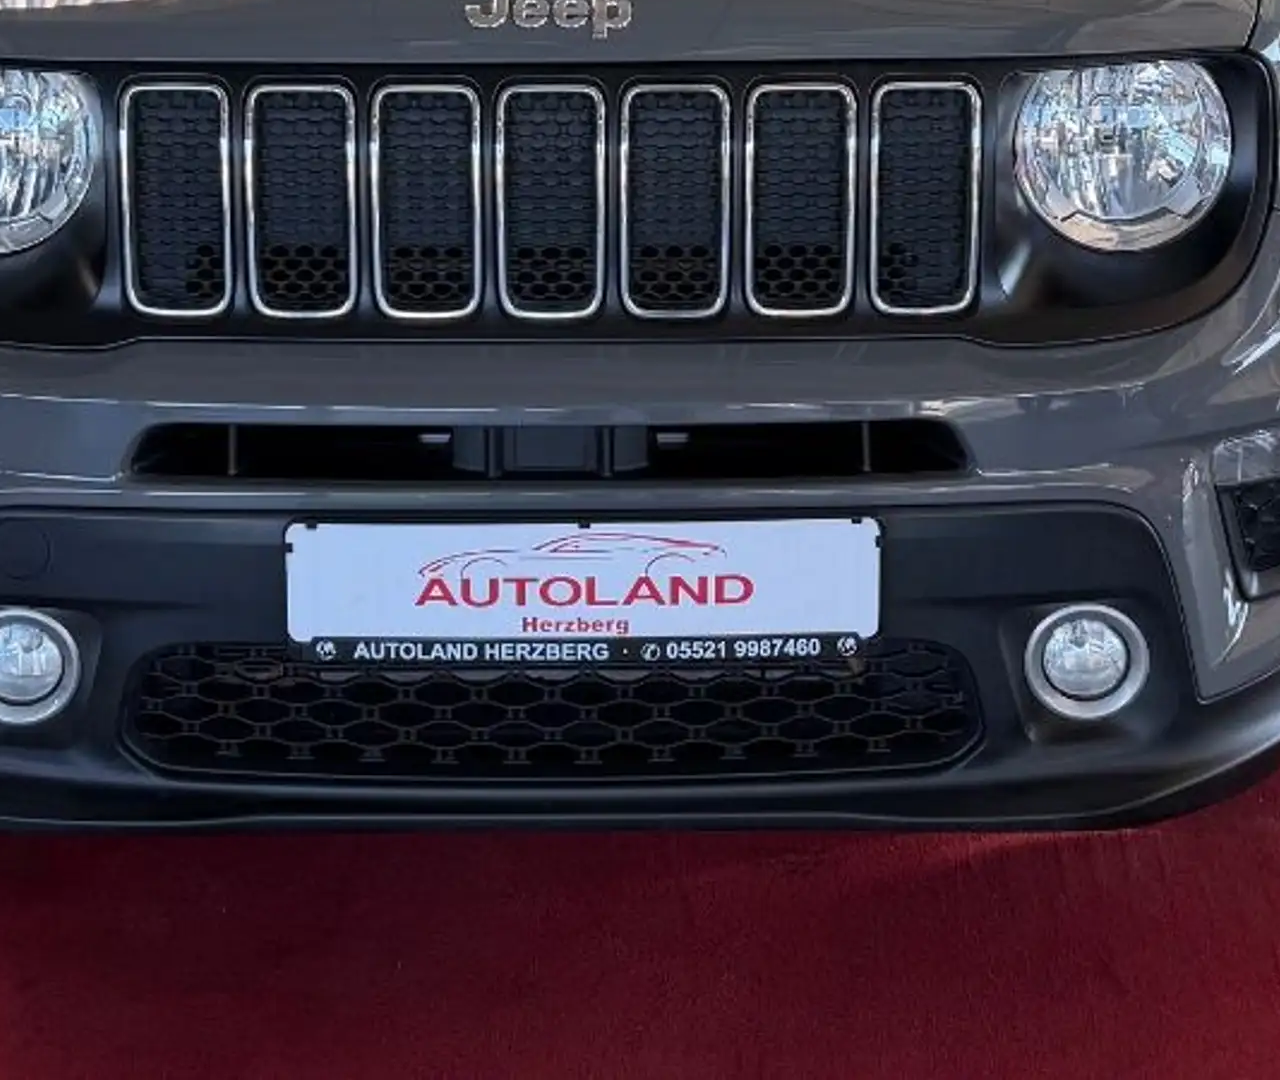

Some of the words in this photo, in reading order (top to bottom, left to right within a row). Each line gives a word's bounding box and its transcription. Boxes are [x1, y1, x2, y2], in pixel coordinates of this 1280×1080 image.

[414, 574, 755, 607] AUTOLAND
[522, 617, 630, 635] Herzberg
[354, 641, 478, 661] AUTOLAND
[485, 642, 610, 661] HERZBERG
[666, 640, 727, 660] 05521
[733, 637, 821, 659] 9987460
